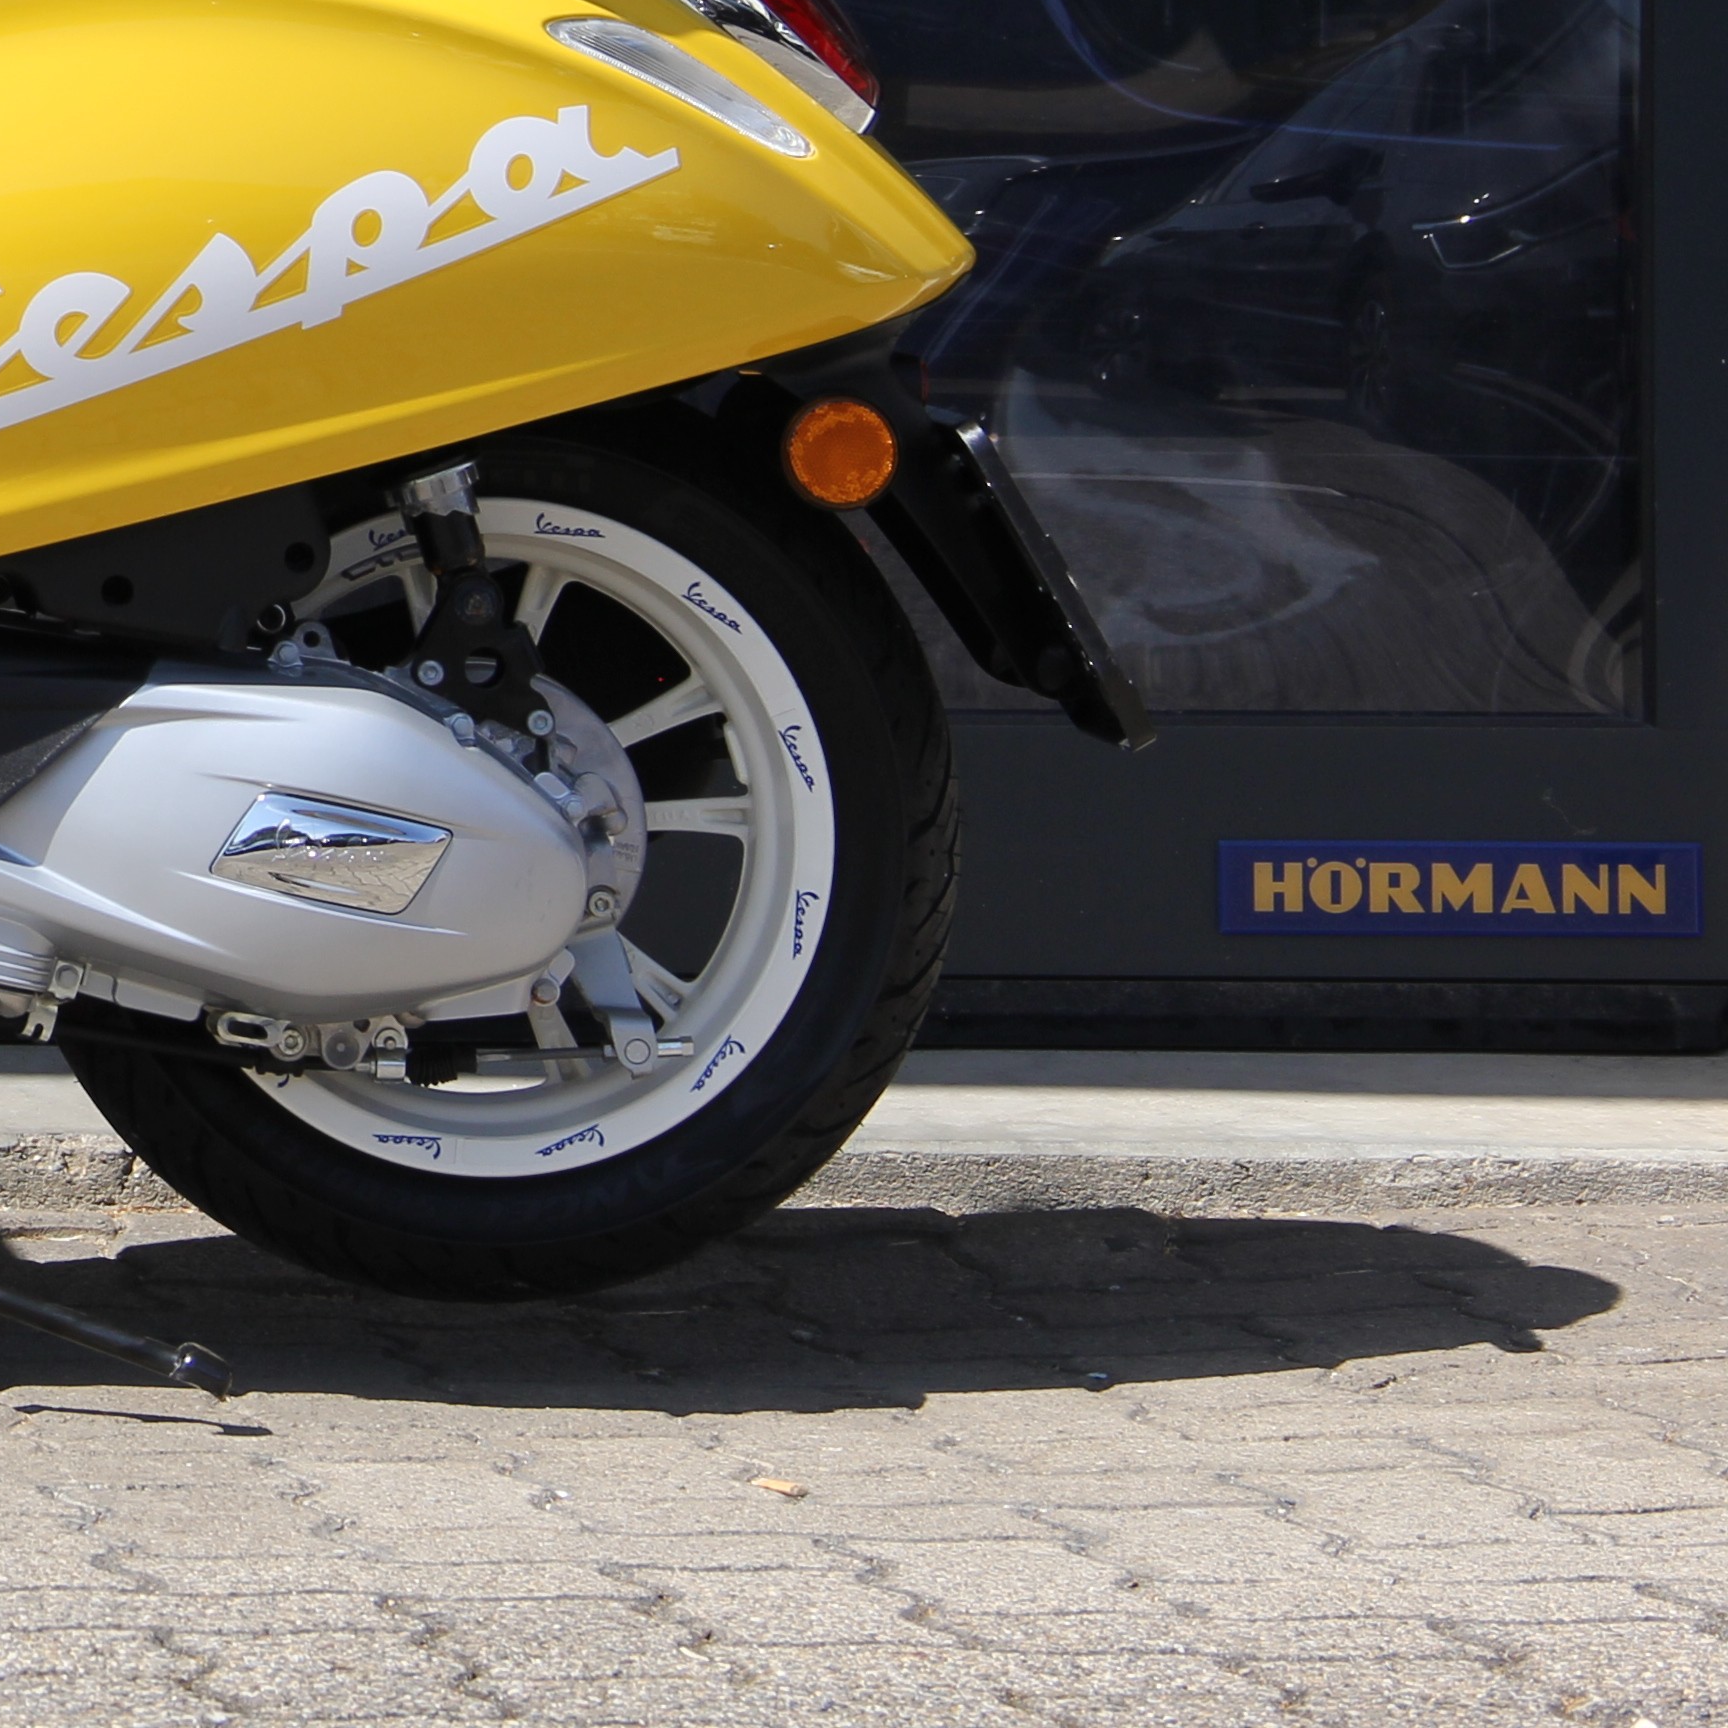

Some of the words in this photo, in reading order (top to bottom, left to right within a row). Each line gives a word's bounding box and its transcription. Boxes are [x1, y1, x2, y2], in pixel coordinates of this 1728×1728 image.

[533, 512, 606, 539] Vespa
[684, 581, 744, 634] Vespa
[780, 725, 817, 793] Vespa
[1253, 857, 1667, 915] HÖRMANN
[794, 889, 819, 960] Vespa
[690, 1036, 746, 1093] Vespa
[373, 1133, 443, 1160] Vespa
[534, 1124, 606, 1157] Vespa
